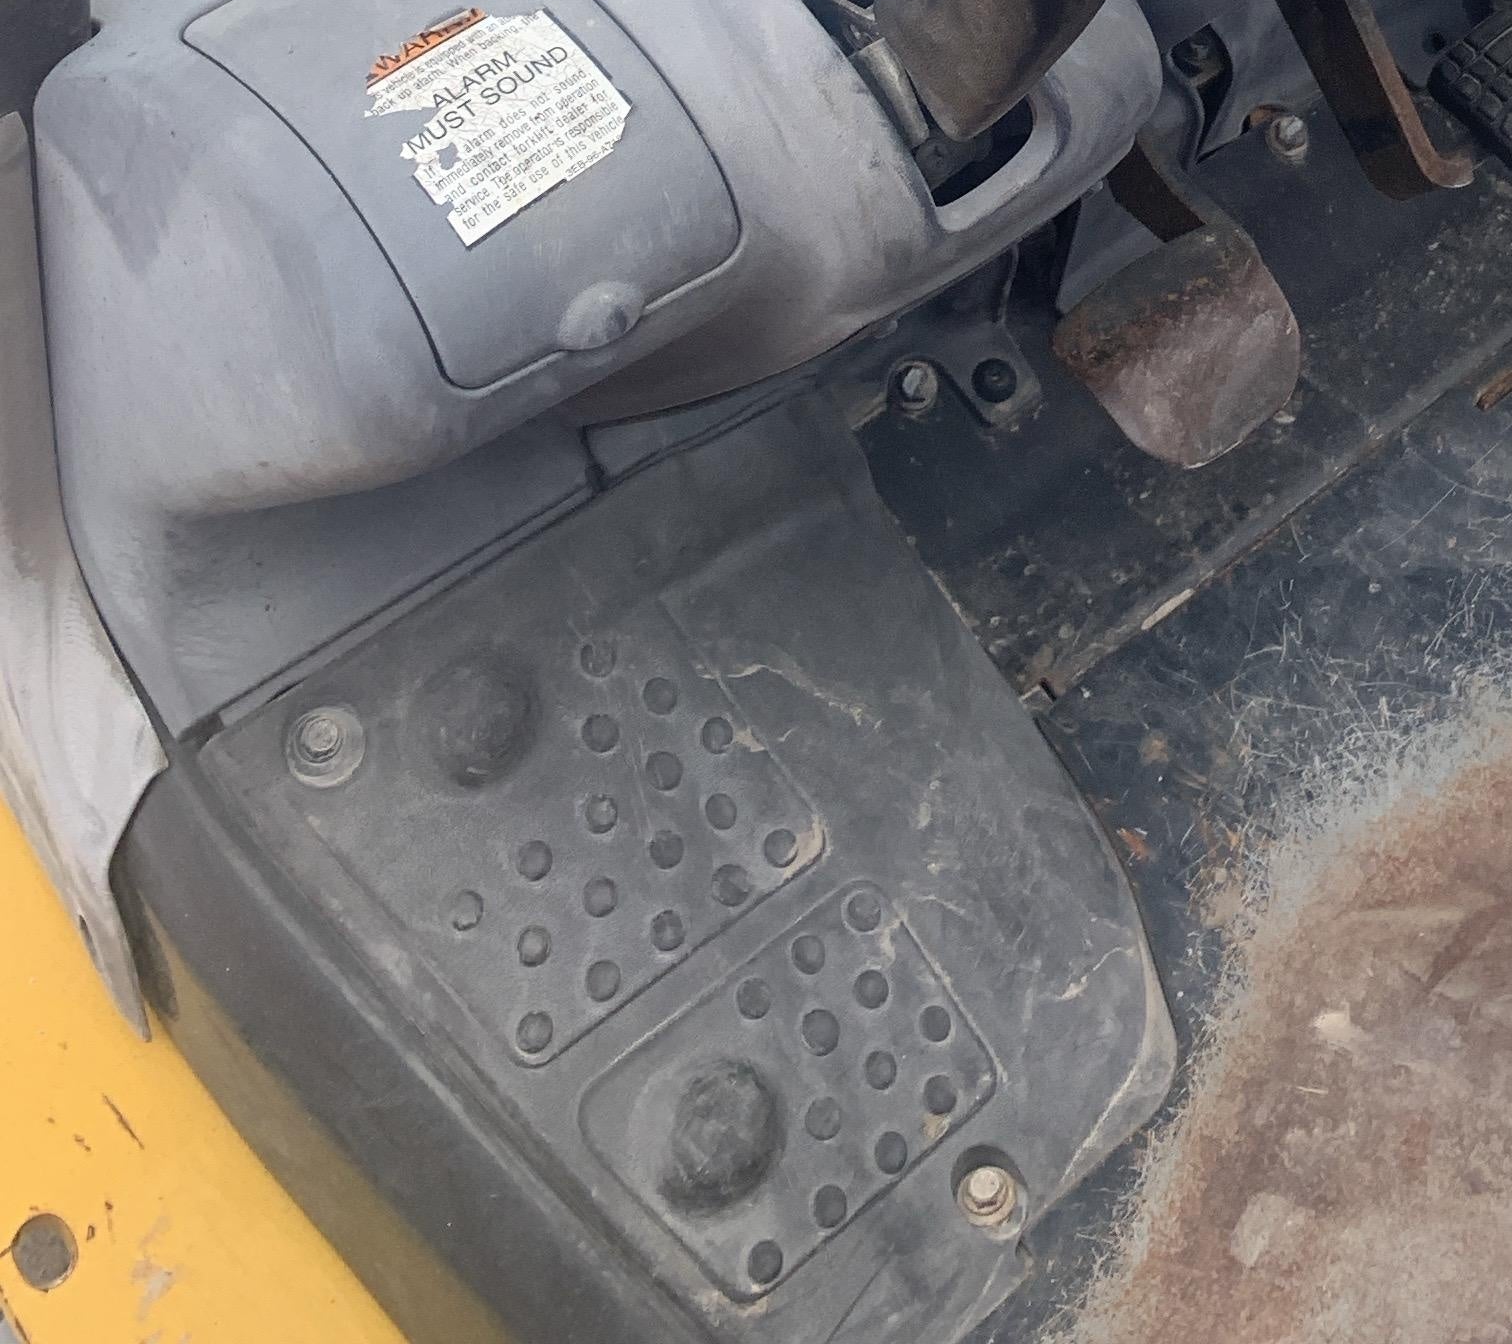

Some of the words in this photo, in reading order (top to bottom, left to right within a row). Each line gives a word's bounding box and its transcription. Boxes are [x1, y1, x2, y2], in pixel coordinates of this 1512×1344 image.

[383, 70, 416, 94] vehicle
[424, 39, 467, 69] equipped
[398, 87, 413, 100] up
[446, 47, 478, 68] When
[406, 98, 476, 155] MUST
[480, 46, 568, 106] SOUND
[432, 50, 518, 108] ALARM
[433, 145, 495, 191] immediately
[494, 122, 532, 150] remove
[529, 106, 556, 126] from
[555, 78, 600, 111] operation
[444, 183, 467, 203] and
[469, 153, 512, 187] contact
[512, 126, 555, 156] forklift
[555, 102, 589, 128] dealer
[589, 90, 610, 105] for
[463, 128, 496, 153] alarm
[498, 108, 527, 129] does
[530, 91, 551, 109] not
[512, 139, 555, 176] operator
[564, 101, 619, 141] responsible
[462, 212, 482, 230] for
[481, 197, 502, 217] the
[503, 180, 528, 202] safe
[528, 166, 550, 184] use
[564, 140, 588, 161] this
